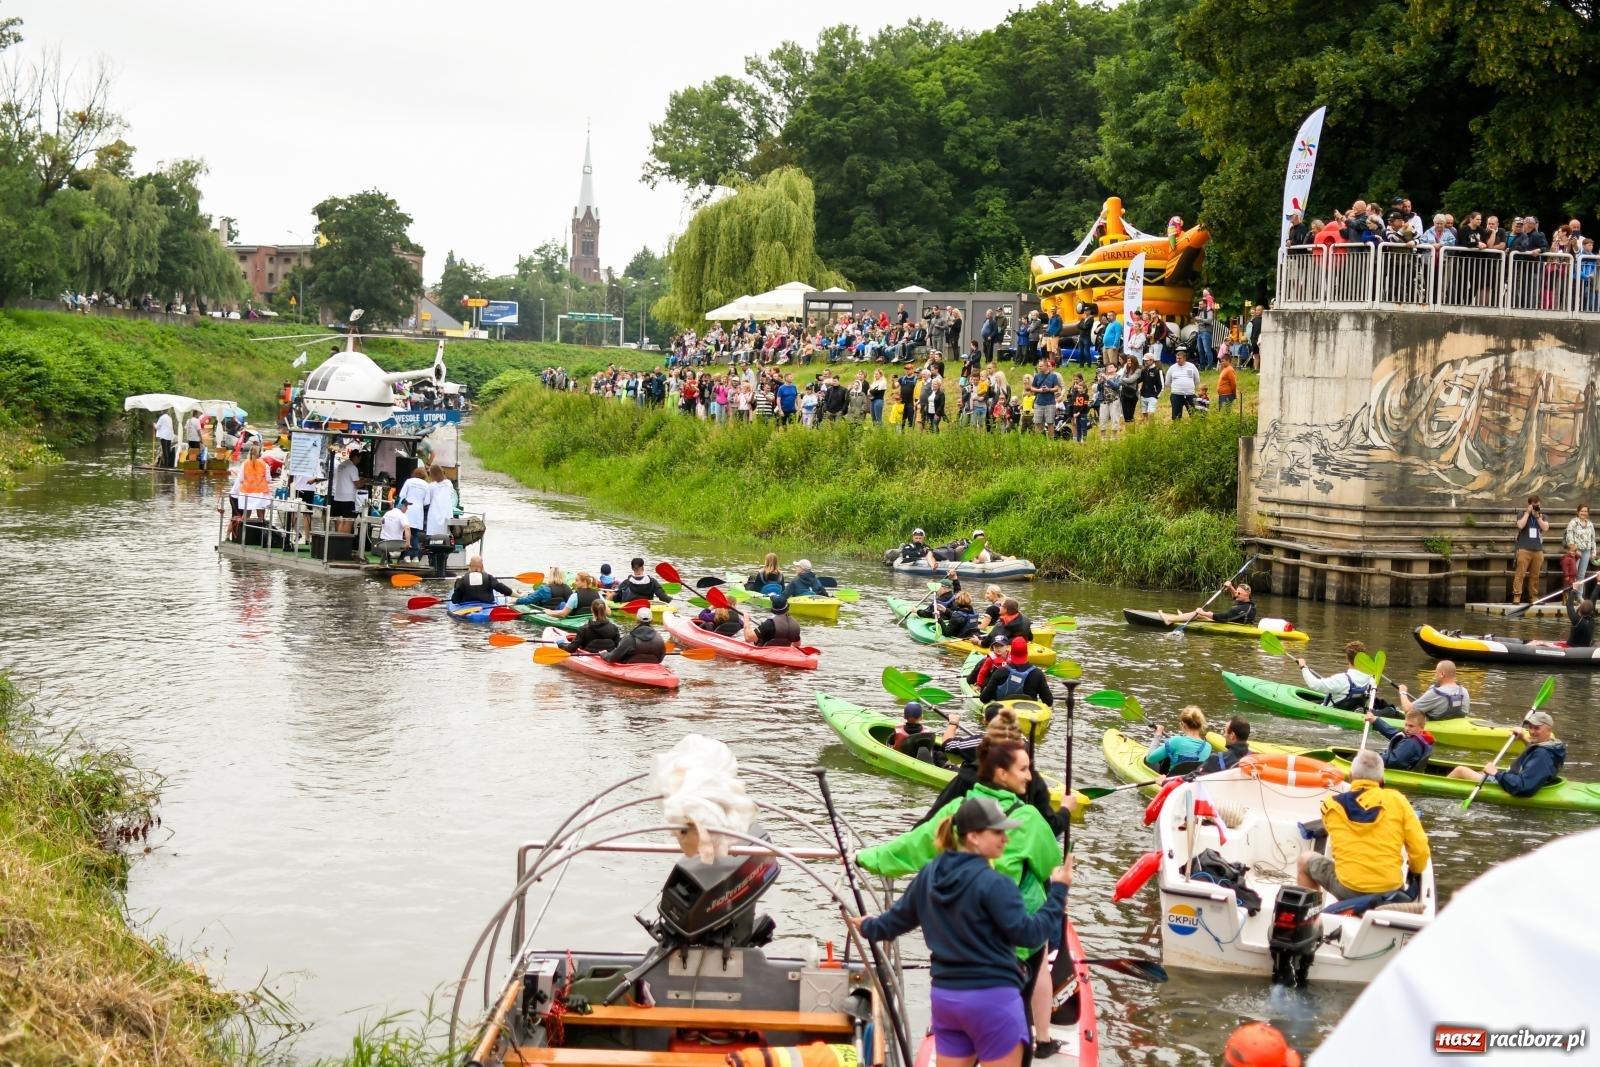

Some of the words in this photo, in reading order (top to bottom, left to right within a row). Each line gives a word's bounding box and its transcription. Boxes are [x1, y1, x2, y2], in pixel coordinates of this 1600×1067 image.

[1102, 250, 1138, 261] PIRATES
[423, 413, 447, 422] UTOPKI
[1168, 914, 1199, 926] CKPiU
